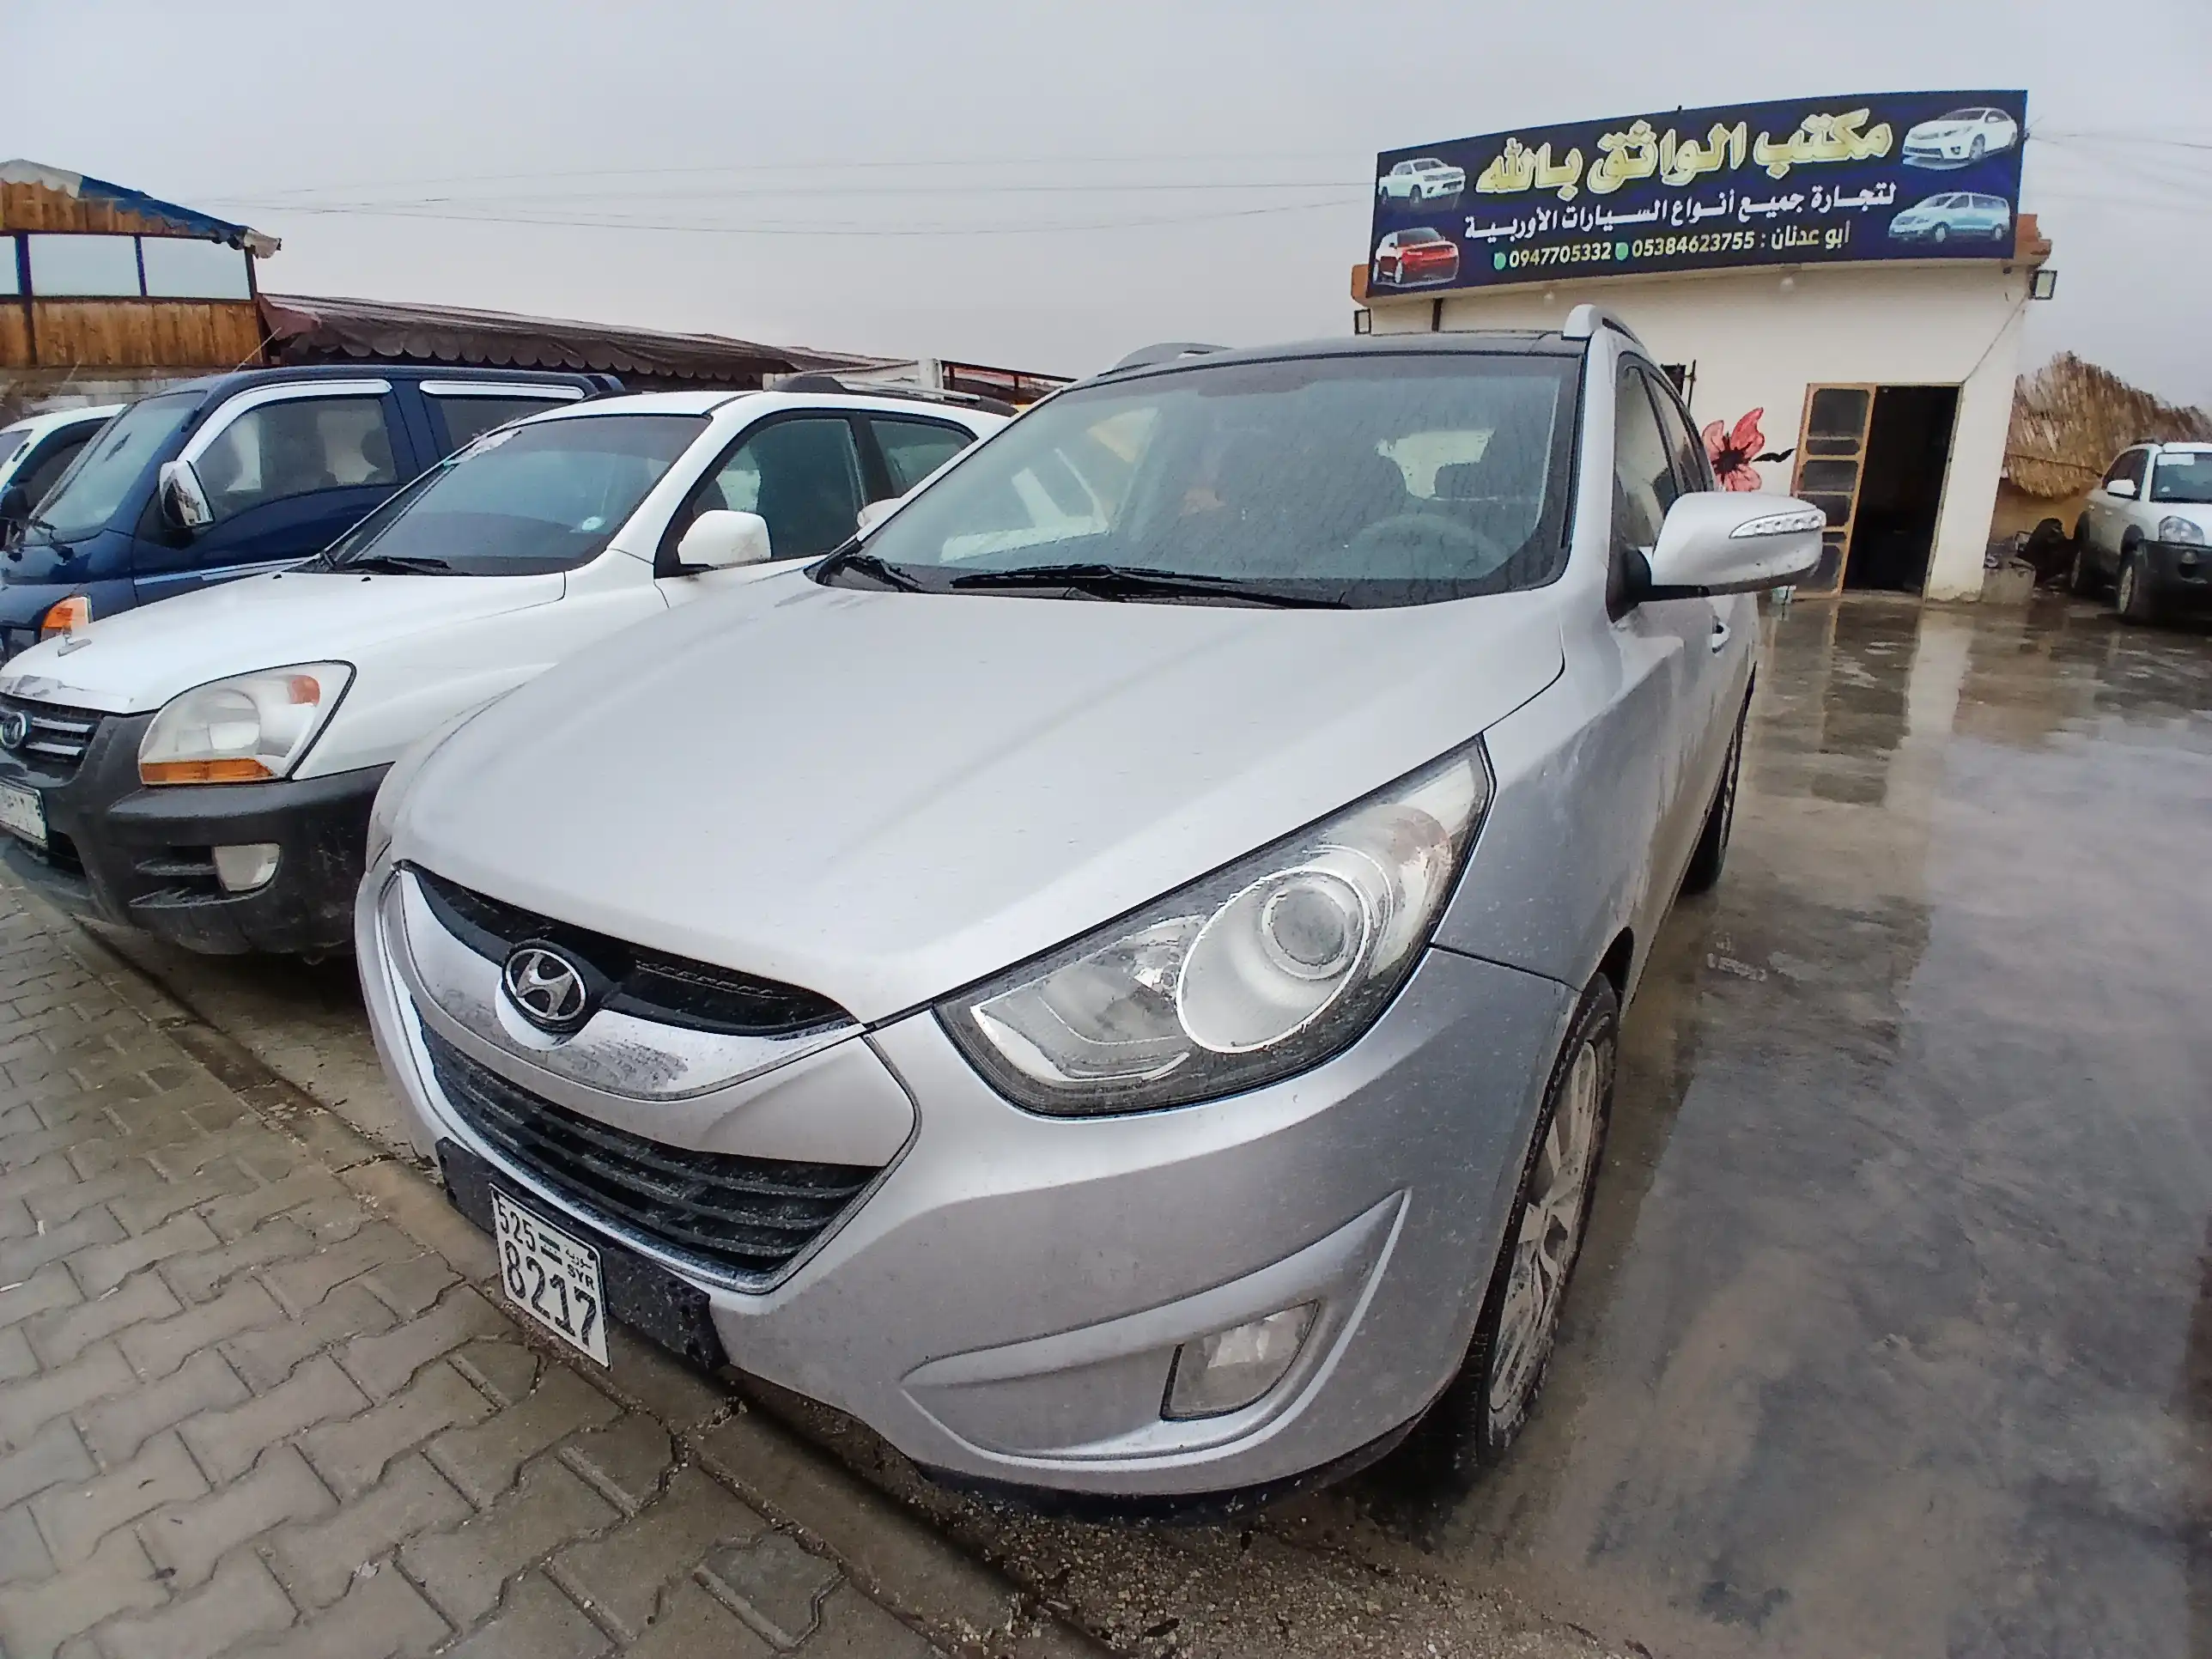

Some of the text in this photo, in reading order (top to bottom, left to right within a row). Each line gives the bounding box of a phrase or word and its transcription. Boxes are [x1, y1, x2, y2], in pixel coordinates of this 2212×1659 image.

[1476, 107, 1893, 201] مكتب الواثق بالله
[1671, 188, 1735, 226] أنواع
[1738, 192, 1805, 222] جميع
[1811, 182, 1896, 213] لتجارة
[1562, 198, 1667, 232] السيارات
[1632, 229, 1755, 258] 05384623755
[1771, 225, 1820, 250] عدنان
[1509, 241, 1611, 268] 0947705332
[497, 1202, 536, 1252] 525
[568, 1264, 595, 1291] SYR
[505, 1240, 597, 1350] 8217
